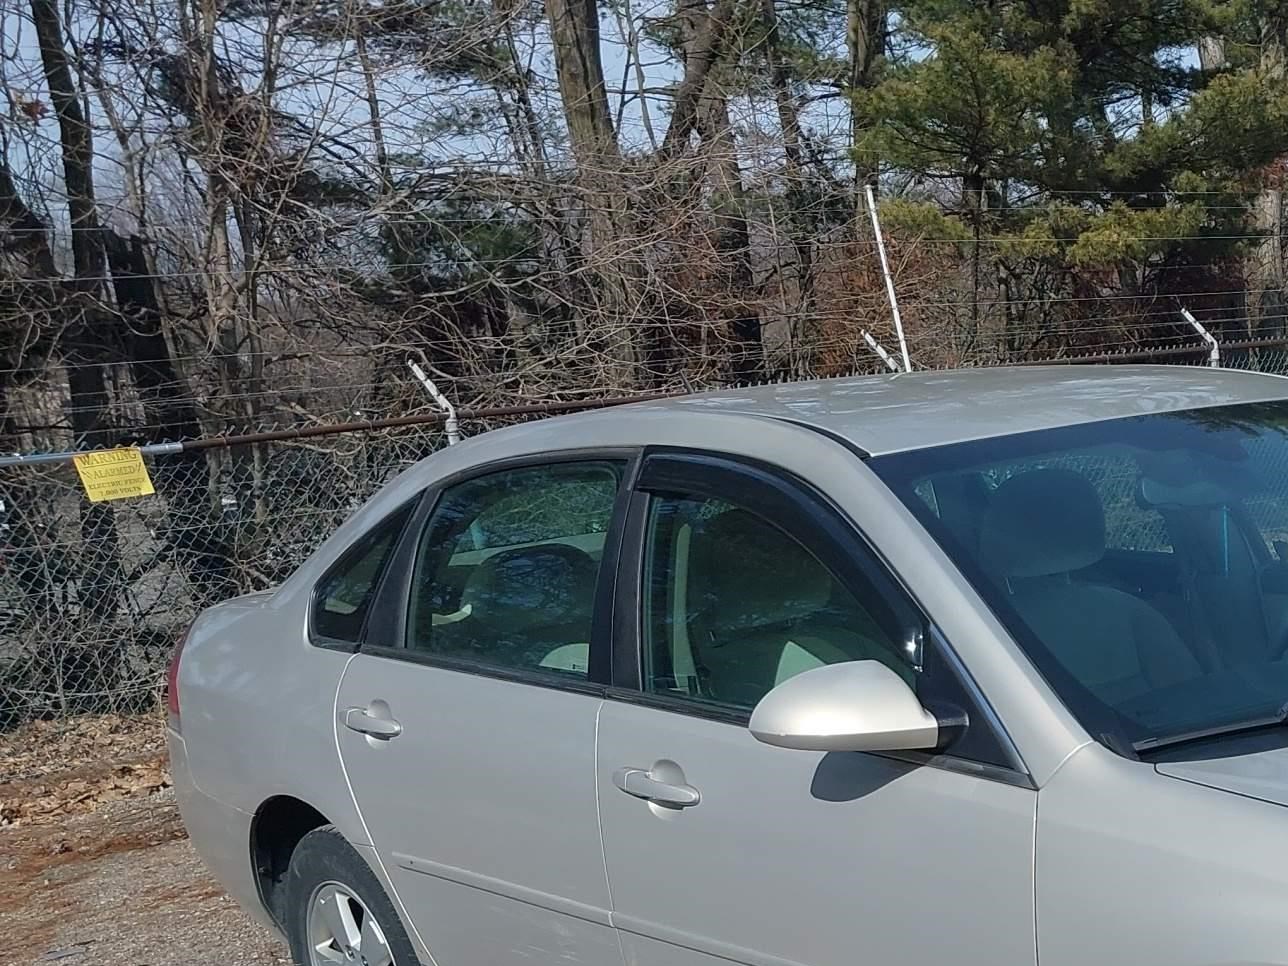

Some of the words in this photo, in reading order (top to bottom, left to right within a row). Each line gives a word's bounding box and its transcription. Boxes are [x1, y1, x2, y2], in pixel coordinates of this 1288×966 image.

[77, 450, 137, 466] WARNING
[93, 465, 135, 480] ALARMED
[89, 480, 121, 489] ELECTRIC
[119, 486, 141, 494] VOLTS
